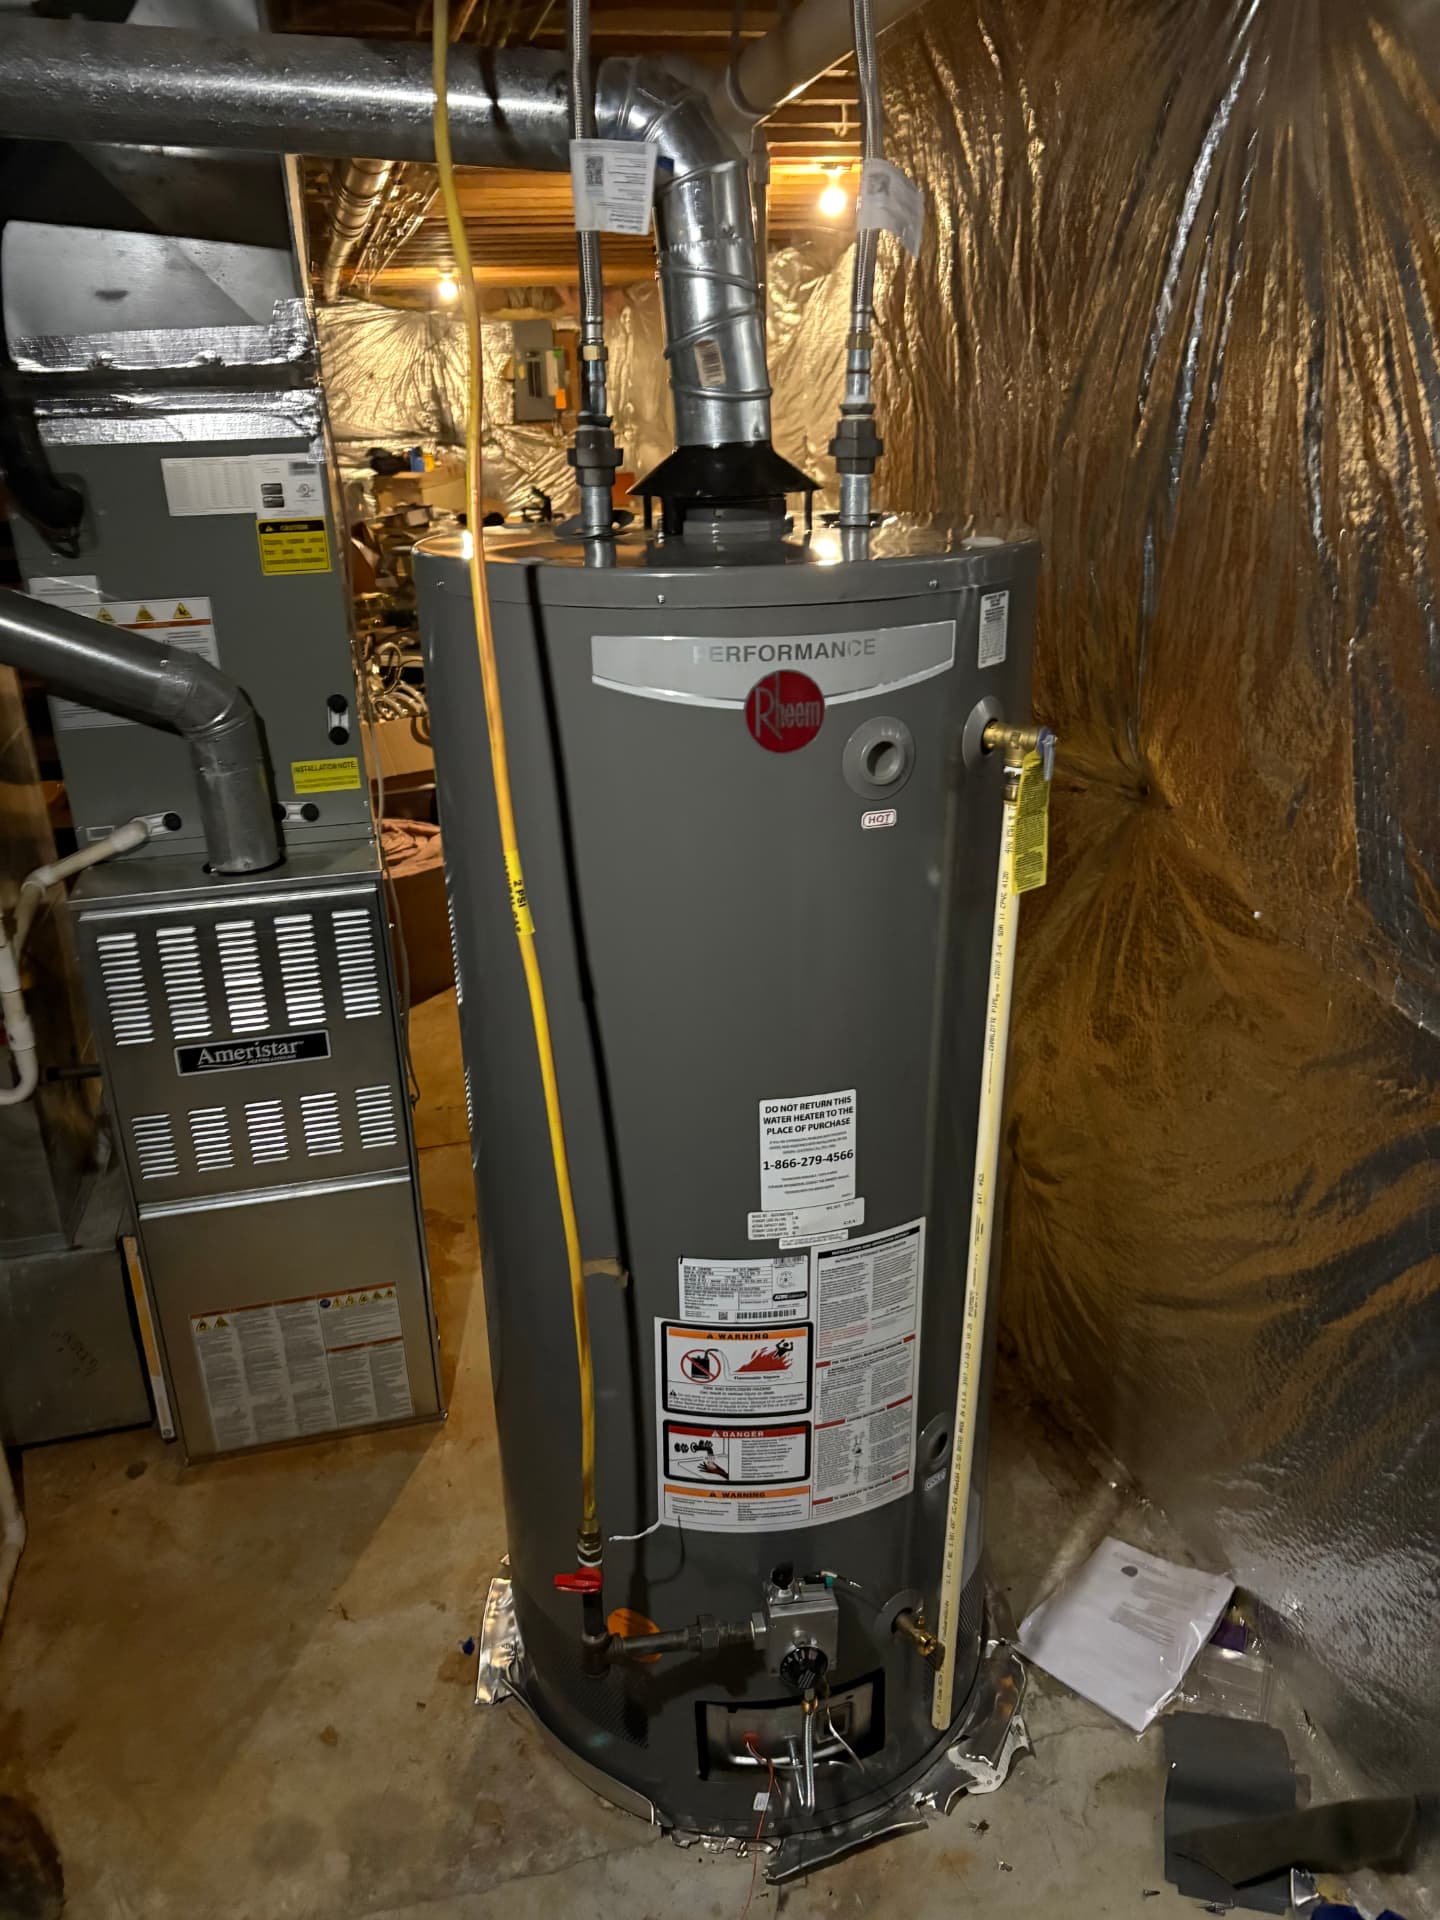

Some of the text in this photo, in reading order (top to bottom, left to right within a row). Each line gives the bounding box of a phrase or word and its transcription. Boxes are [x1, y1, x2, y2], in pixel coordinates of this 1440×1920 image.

[692, 638, 876, 665] PERFORMANCE
[755, 671, 821, 740] Rheem
[868, 814, 890, 825] HOT
[197, 1041, 304, 1066] Ameristar
[765, 1096, 852, 1114] DO NOT RETURN THIS
[763, 1106, 854, 1125] WATER HEATER TO THE
[766, 1117, 851, 1136] PLACE OF PURCHASE
[763, 1149, 854, 1171] 1-866-279-4566
[718, 1333, 769, 1341] WARNING
[722, 1491, 766, 1499] WARNING
